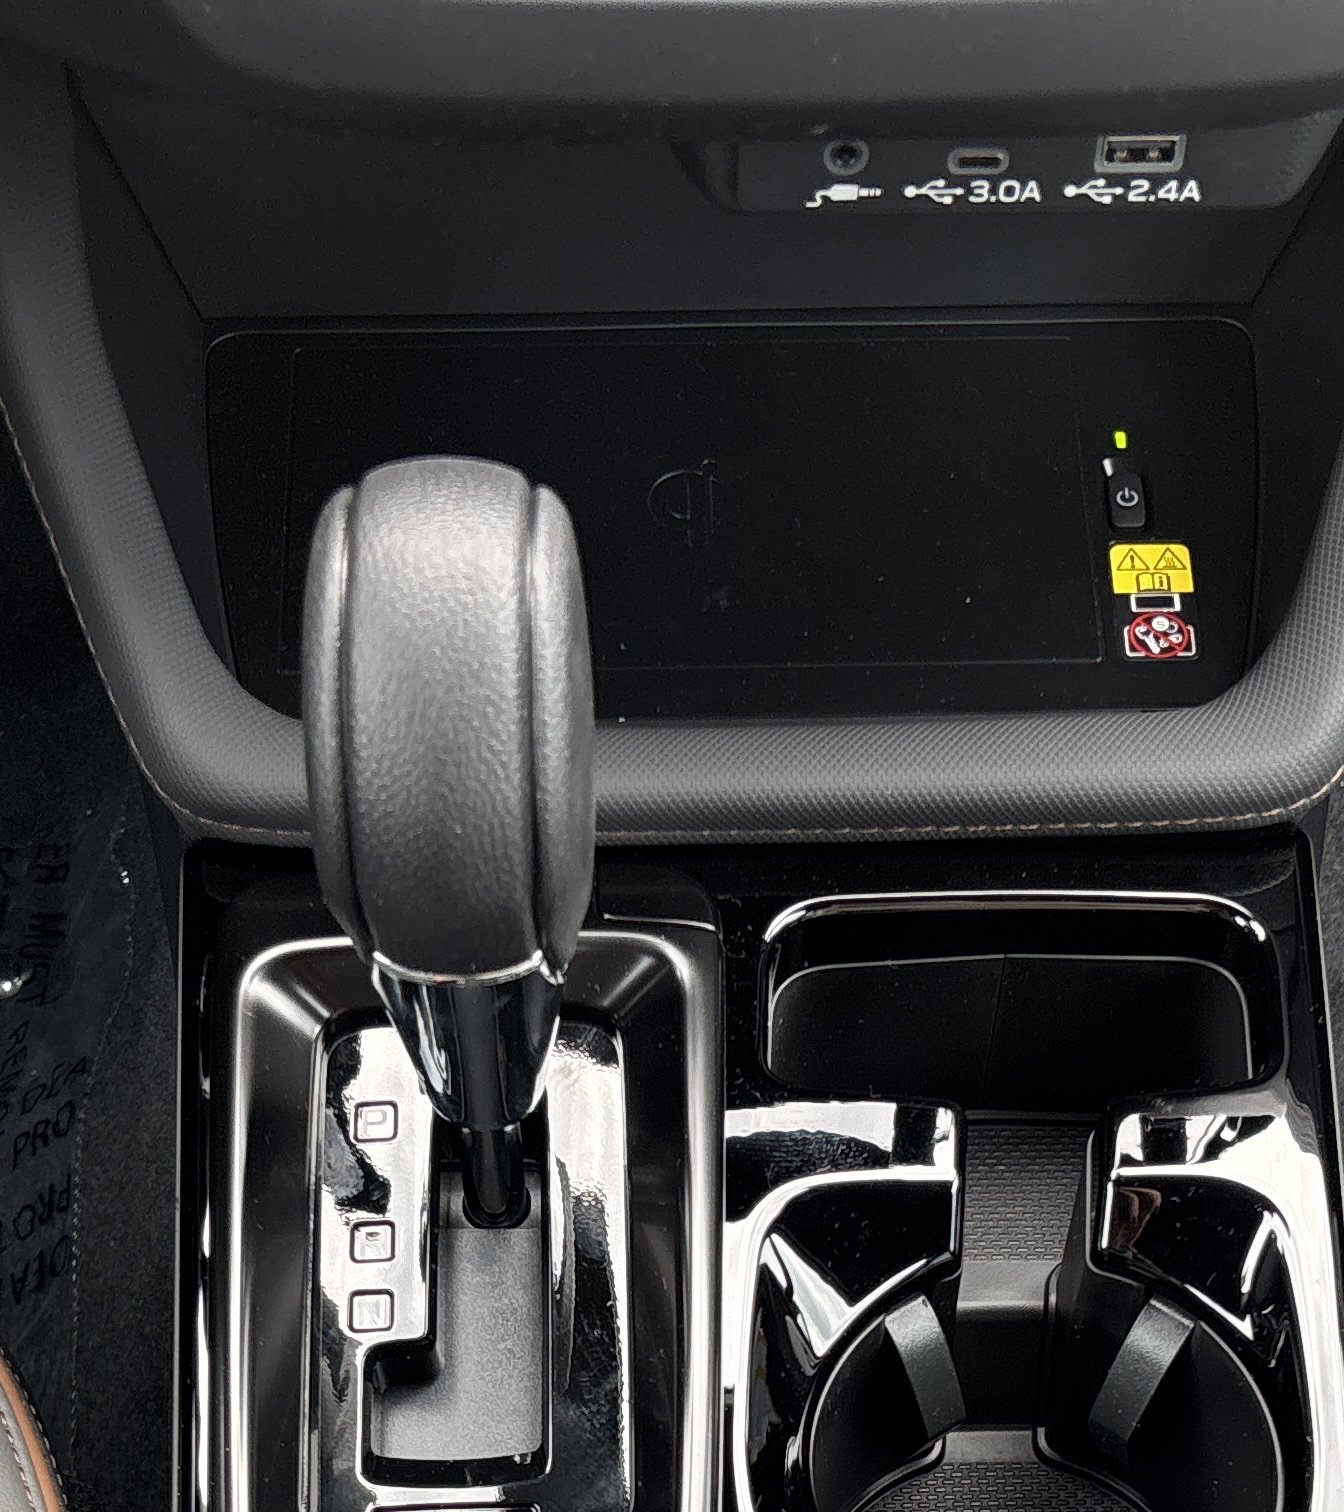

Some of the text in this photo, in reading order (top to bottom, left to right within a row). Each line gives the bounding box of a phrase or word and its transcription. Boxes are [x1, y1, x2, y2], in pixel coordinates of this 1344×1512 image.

[967, 180, 1041, 203] 3.0A
[1127, 180, 1202, 203] 2.4A
[12, 1100, 75, 1170] PRO
[362, 1108, 387, 1137] P
